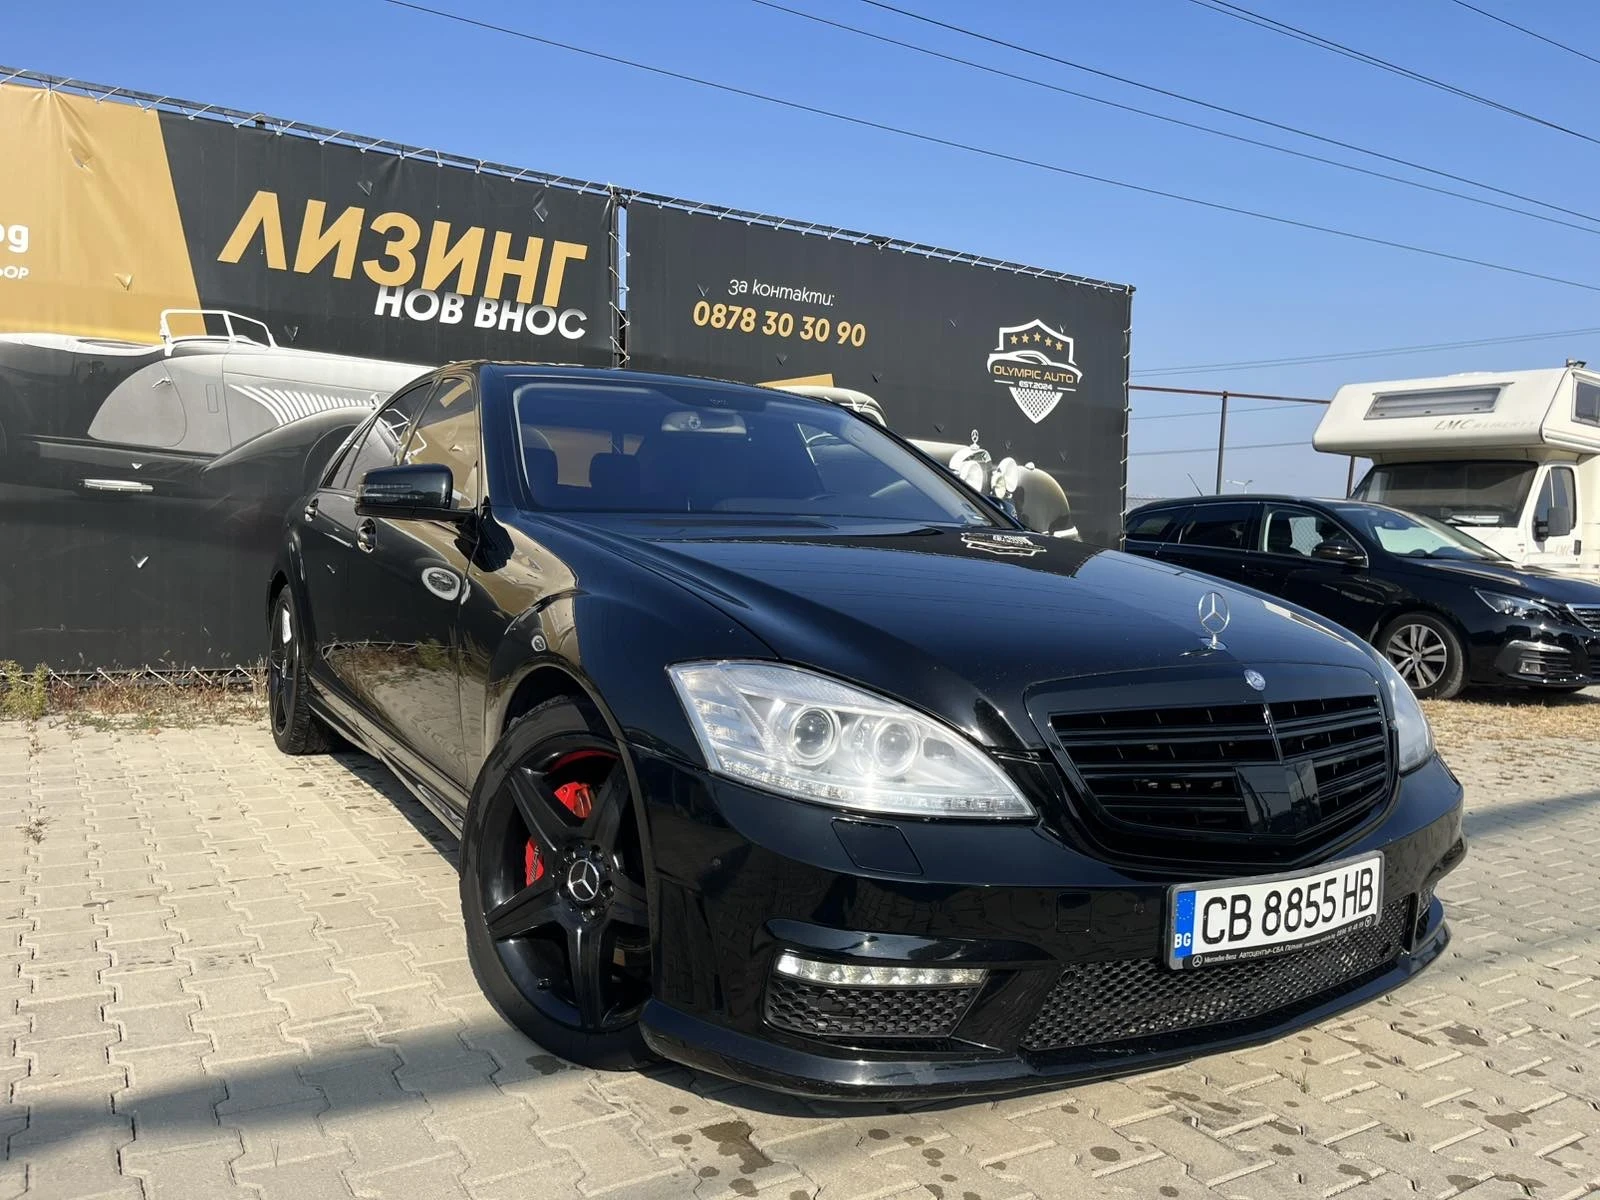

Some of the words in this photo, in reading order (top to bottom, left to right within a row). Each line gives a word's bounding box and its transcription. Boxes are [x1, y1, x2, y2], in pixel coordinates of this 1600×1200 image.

[217, 190, 588, 307] ЛИЗИНГ
[374, 285, 466, 325] НОВ
[474, 296, 588, 340] ВНОС
[752, 279, 835, 306] контакти:
[693, 300, 756, 332] 0878
[762, 310, 794, 337] 30
[800, 315, 830, 342] 30
[837, 321, 866, 347] 90
[993, 365, 1041, 379] OLYMPIC
[1044, 371, 1074, 383] AUTO
[1202, 894, 1252, 945] CB
[1261, 877, 1337, 937] 8855
[1342, 867, 1373, 918] HB
[1174, 932, 1192, 949] BG
